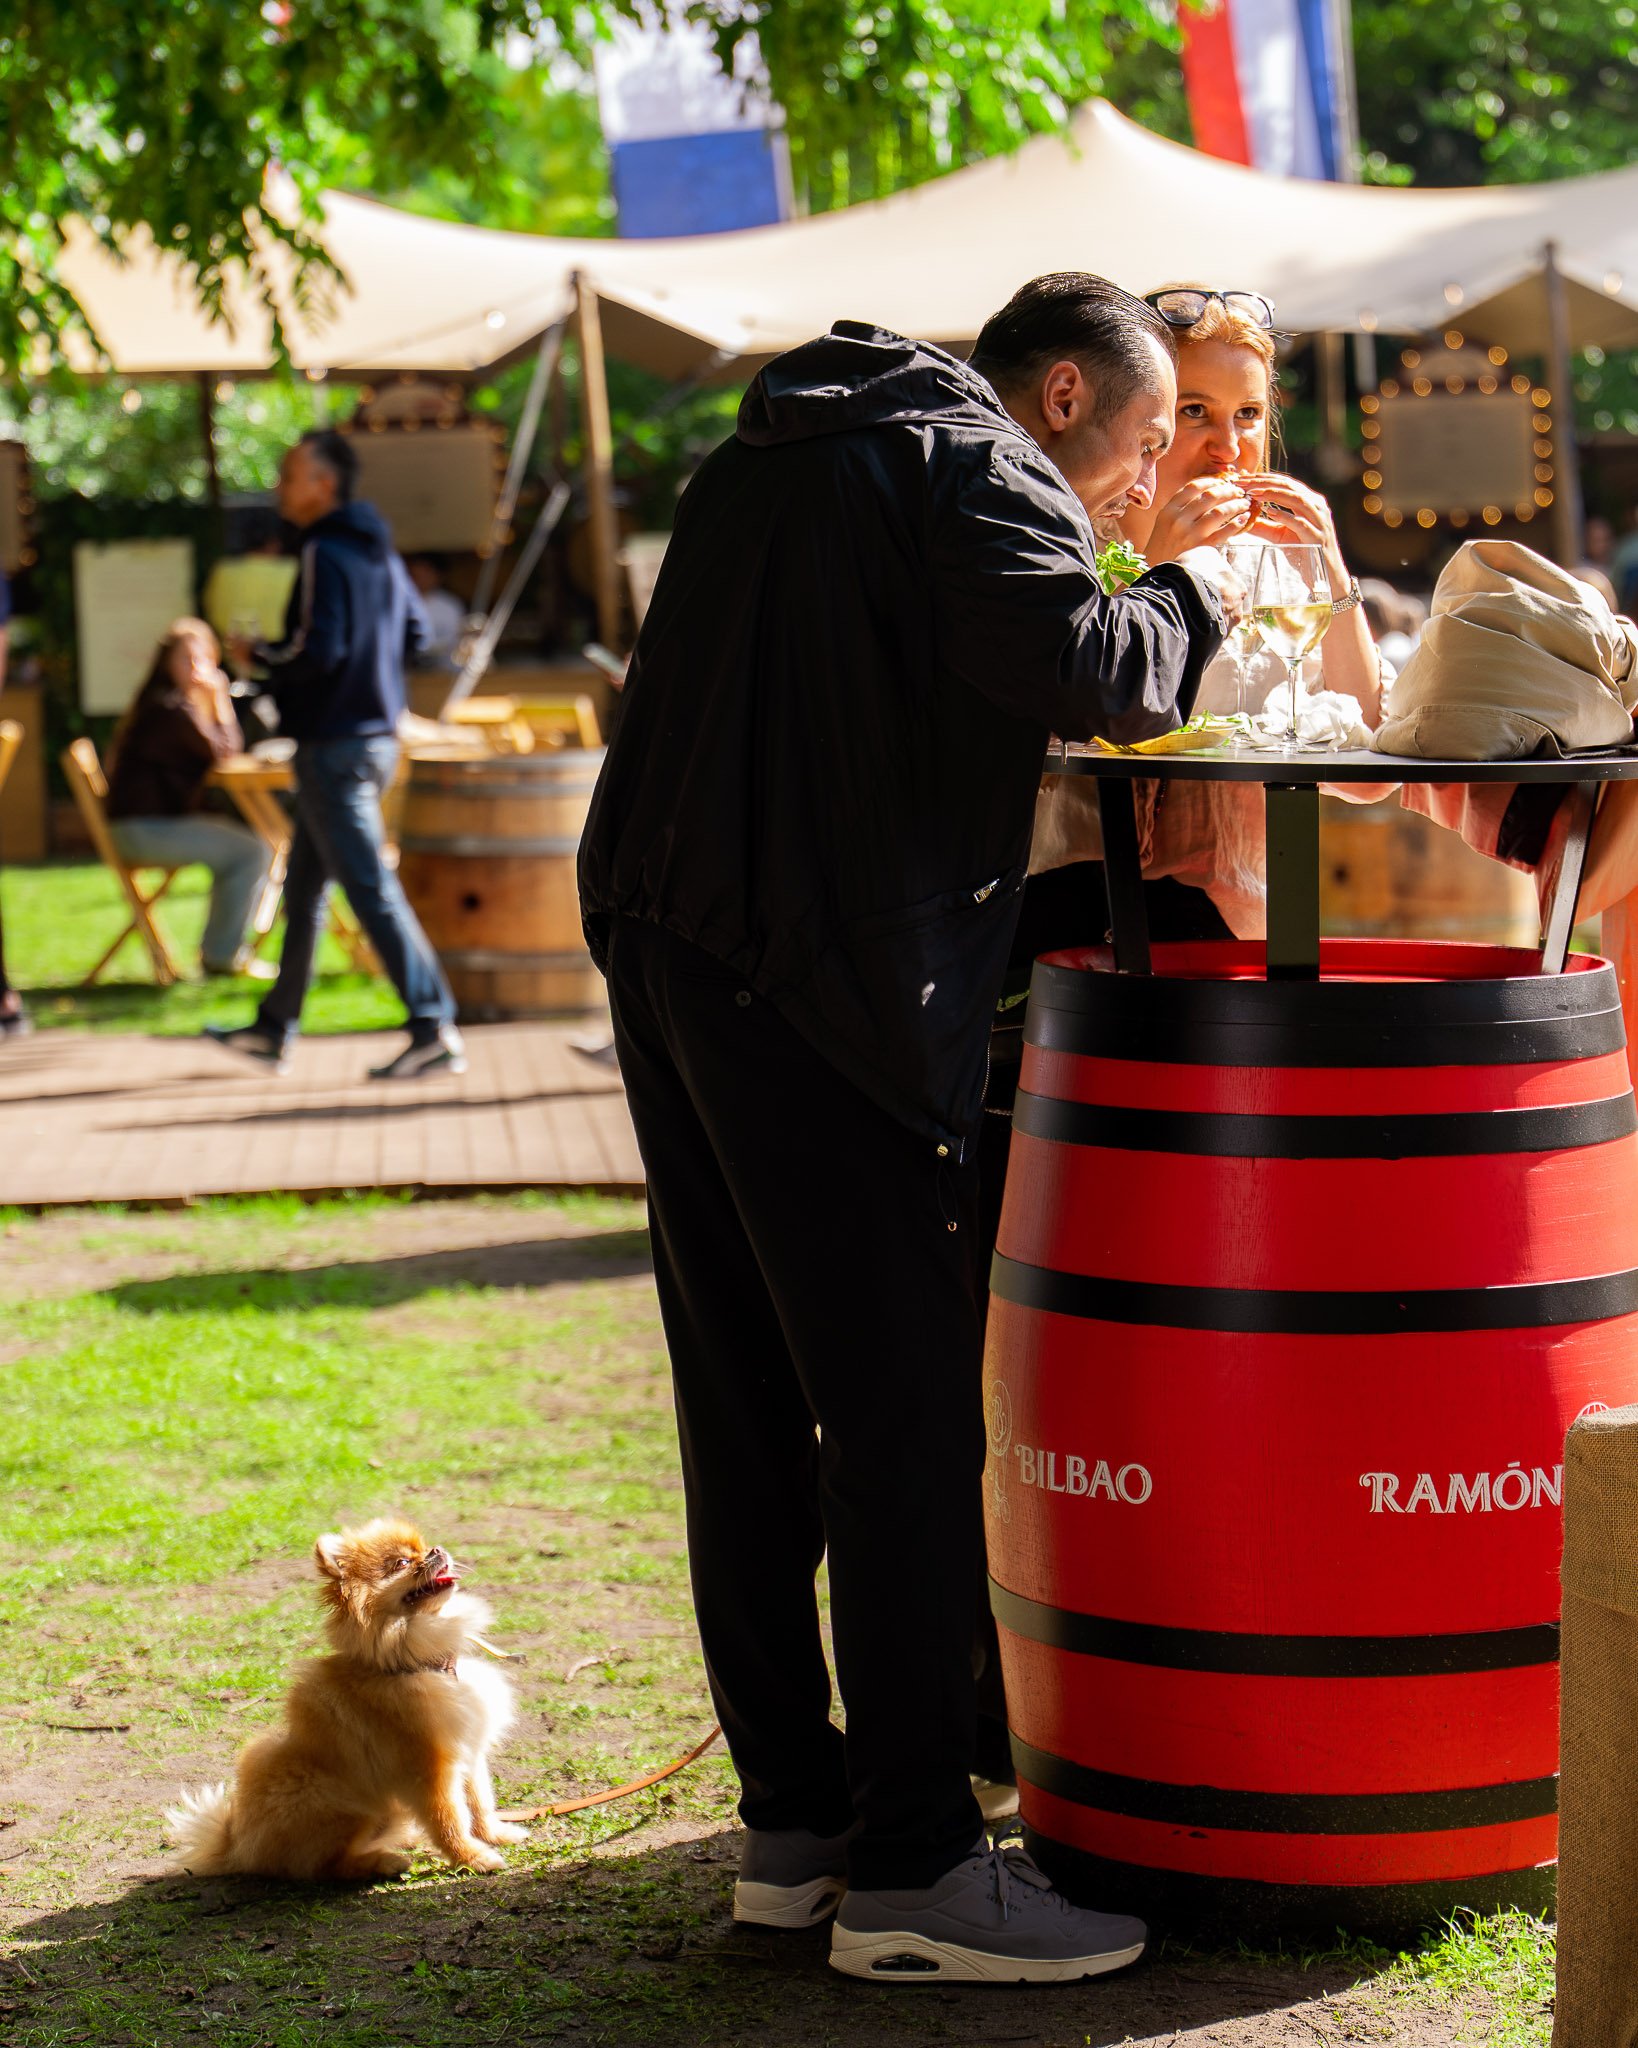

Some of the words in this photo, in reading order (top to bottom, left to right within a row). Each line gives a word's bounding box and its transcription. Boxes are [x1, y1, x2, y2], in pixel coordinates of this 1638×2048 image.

[1014, 1444, 1153, 1505] BILBAO
[1359, 1461, 1564, 1514] RAMÓN
[986, 1894, 1022, 1913] SKEERS
